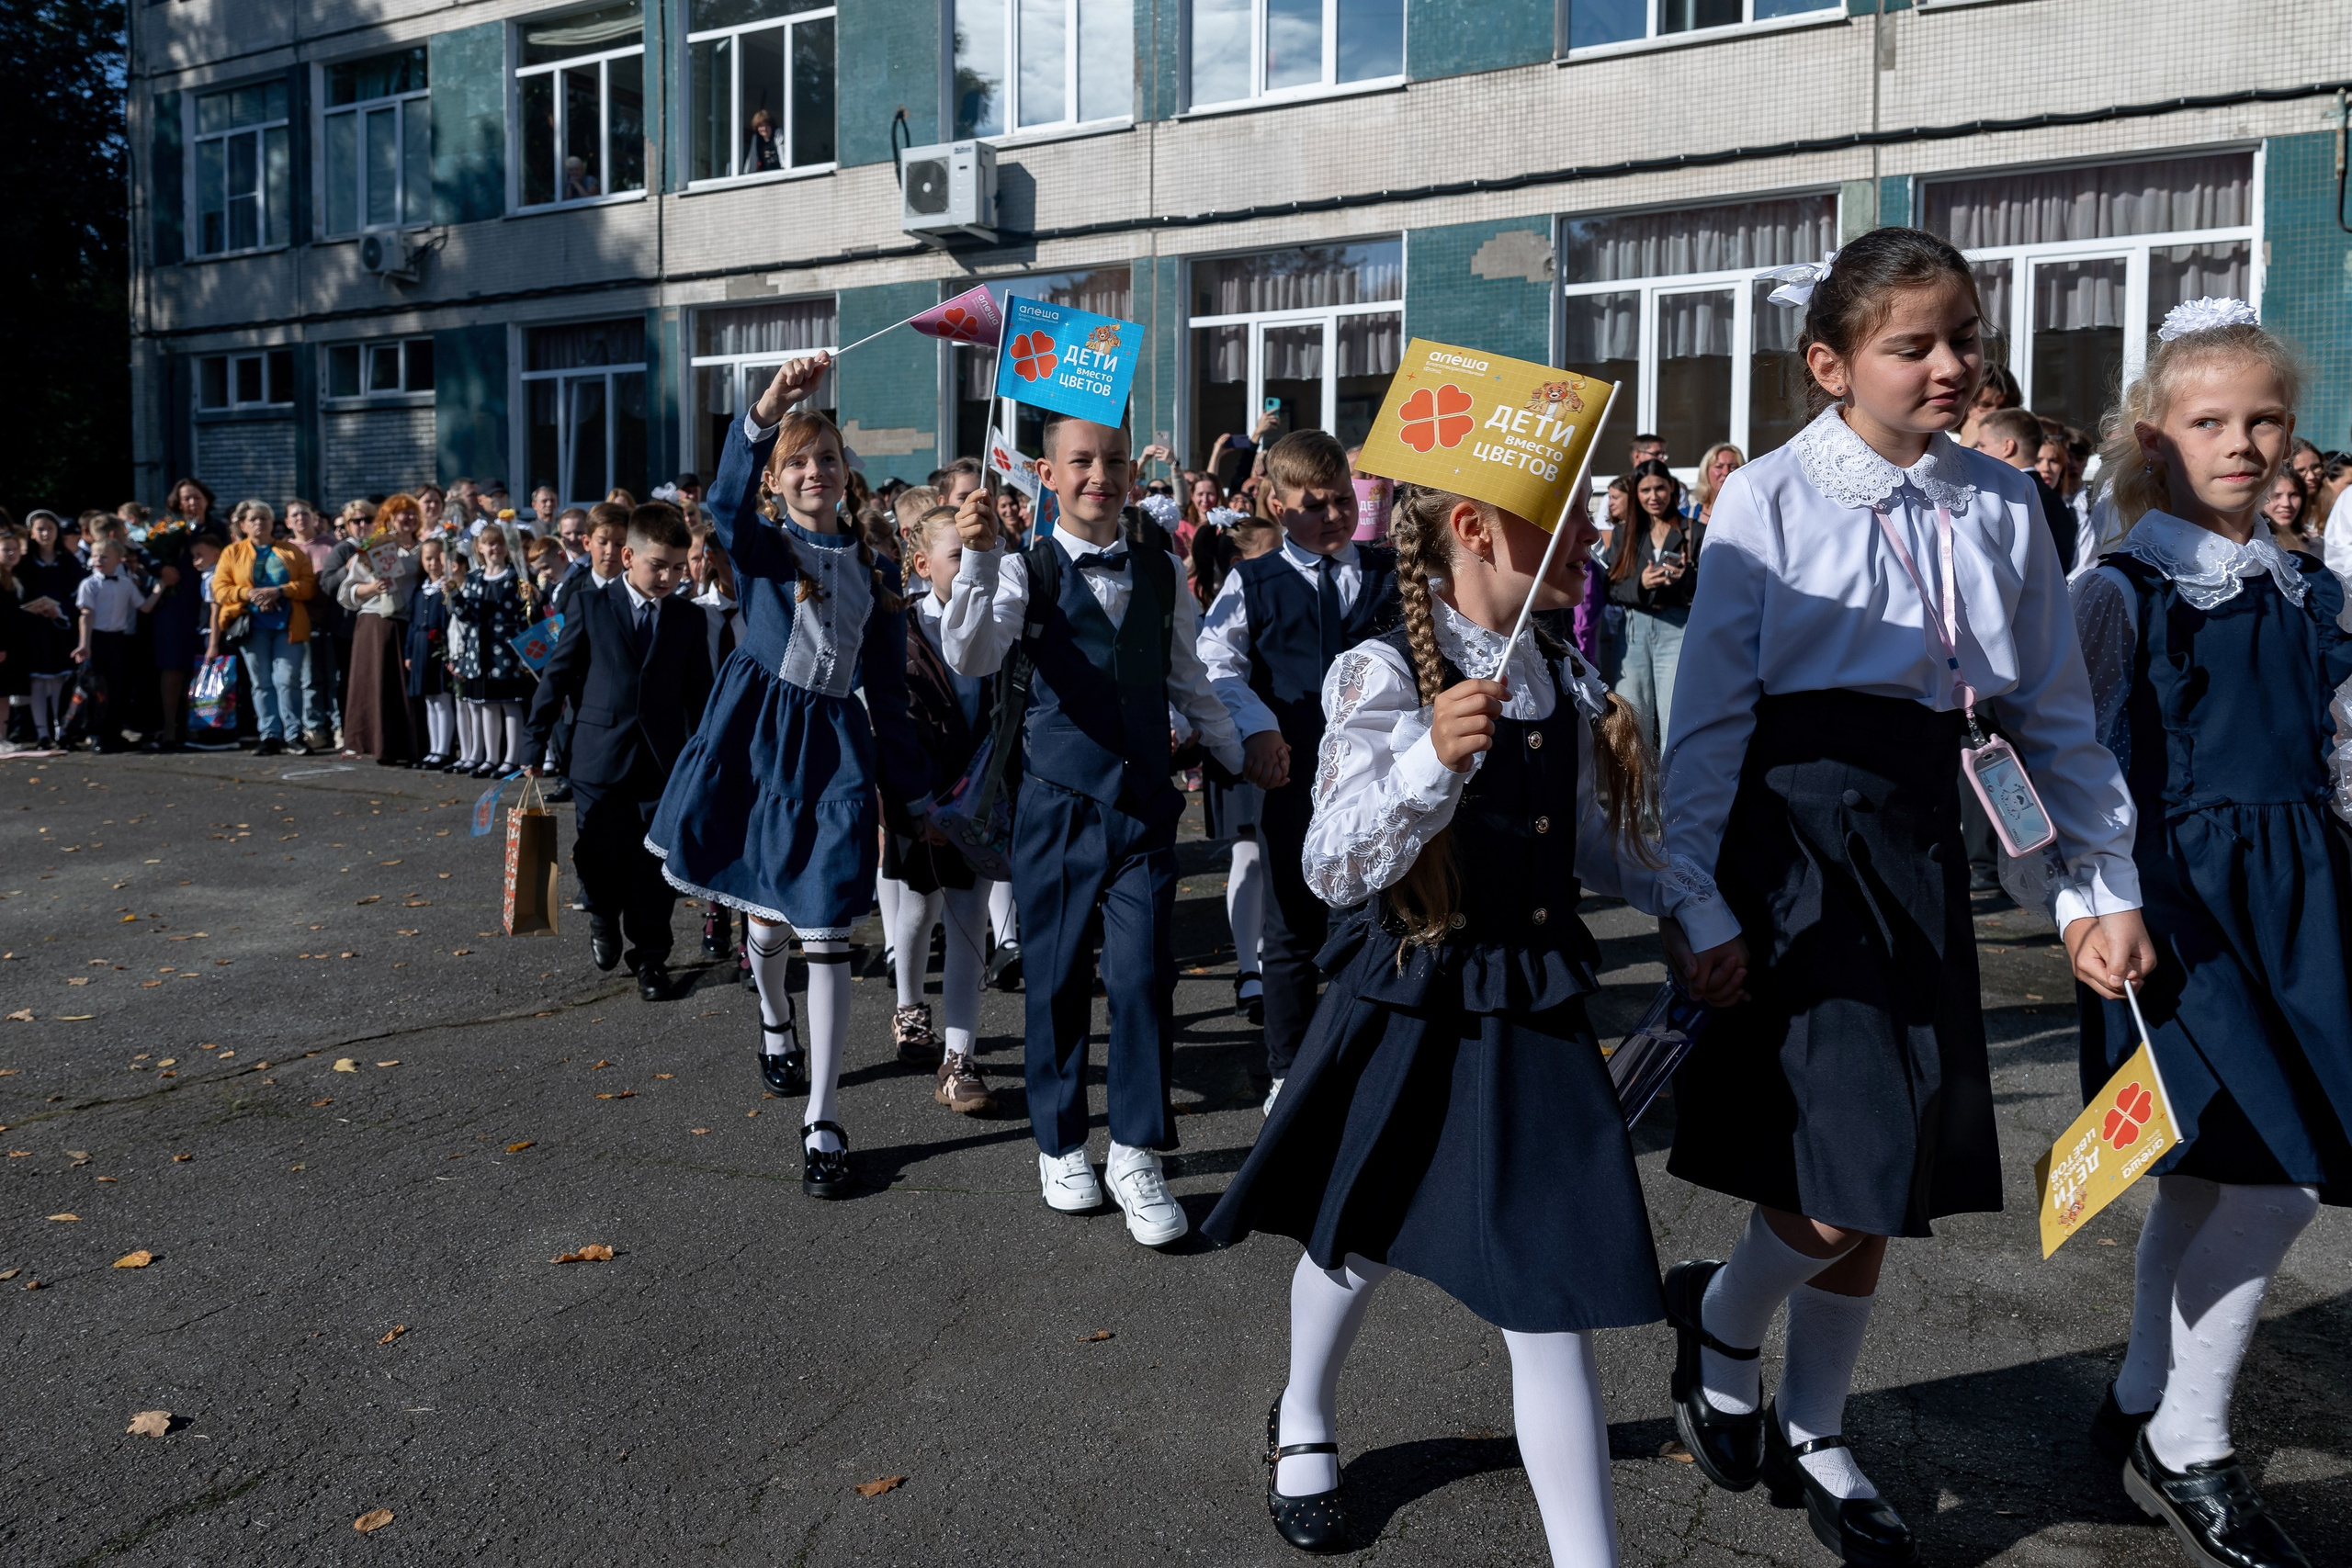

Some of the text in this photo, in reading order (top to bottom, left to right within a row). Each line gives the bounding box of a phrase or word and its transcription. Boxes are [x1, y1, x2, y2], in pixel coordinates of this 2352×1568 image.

[1063, 344, 1118, 372] ДЕТИ
[1058, 373, 1112, 397] ЦВЕТОВ
[1076, 367, 1113, 383] вместо
[1484, 404, 1576, 448] ДЕТИ
[1473, 441, 1559, 482] ЦВЕТОВ
[1504, 434, 1564, 462] вместо
[2053, 1145, 2099, 1210] ДЕТИ
